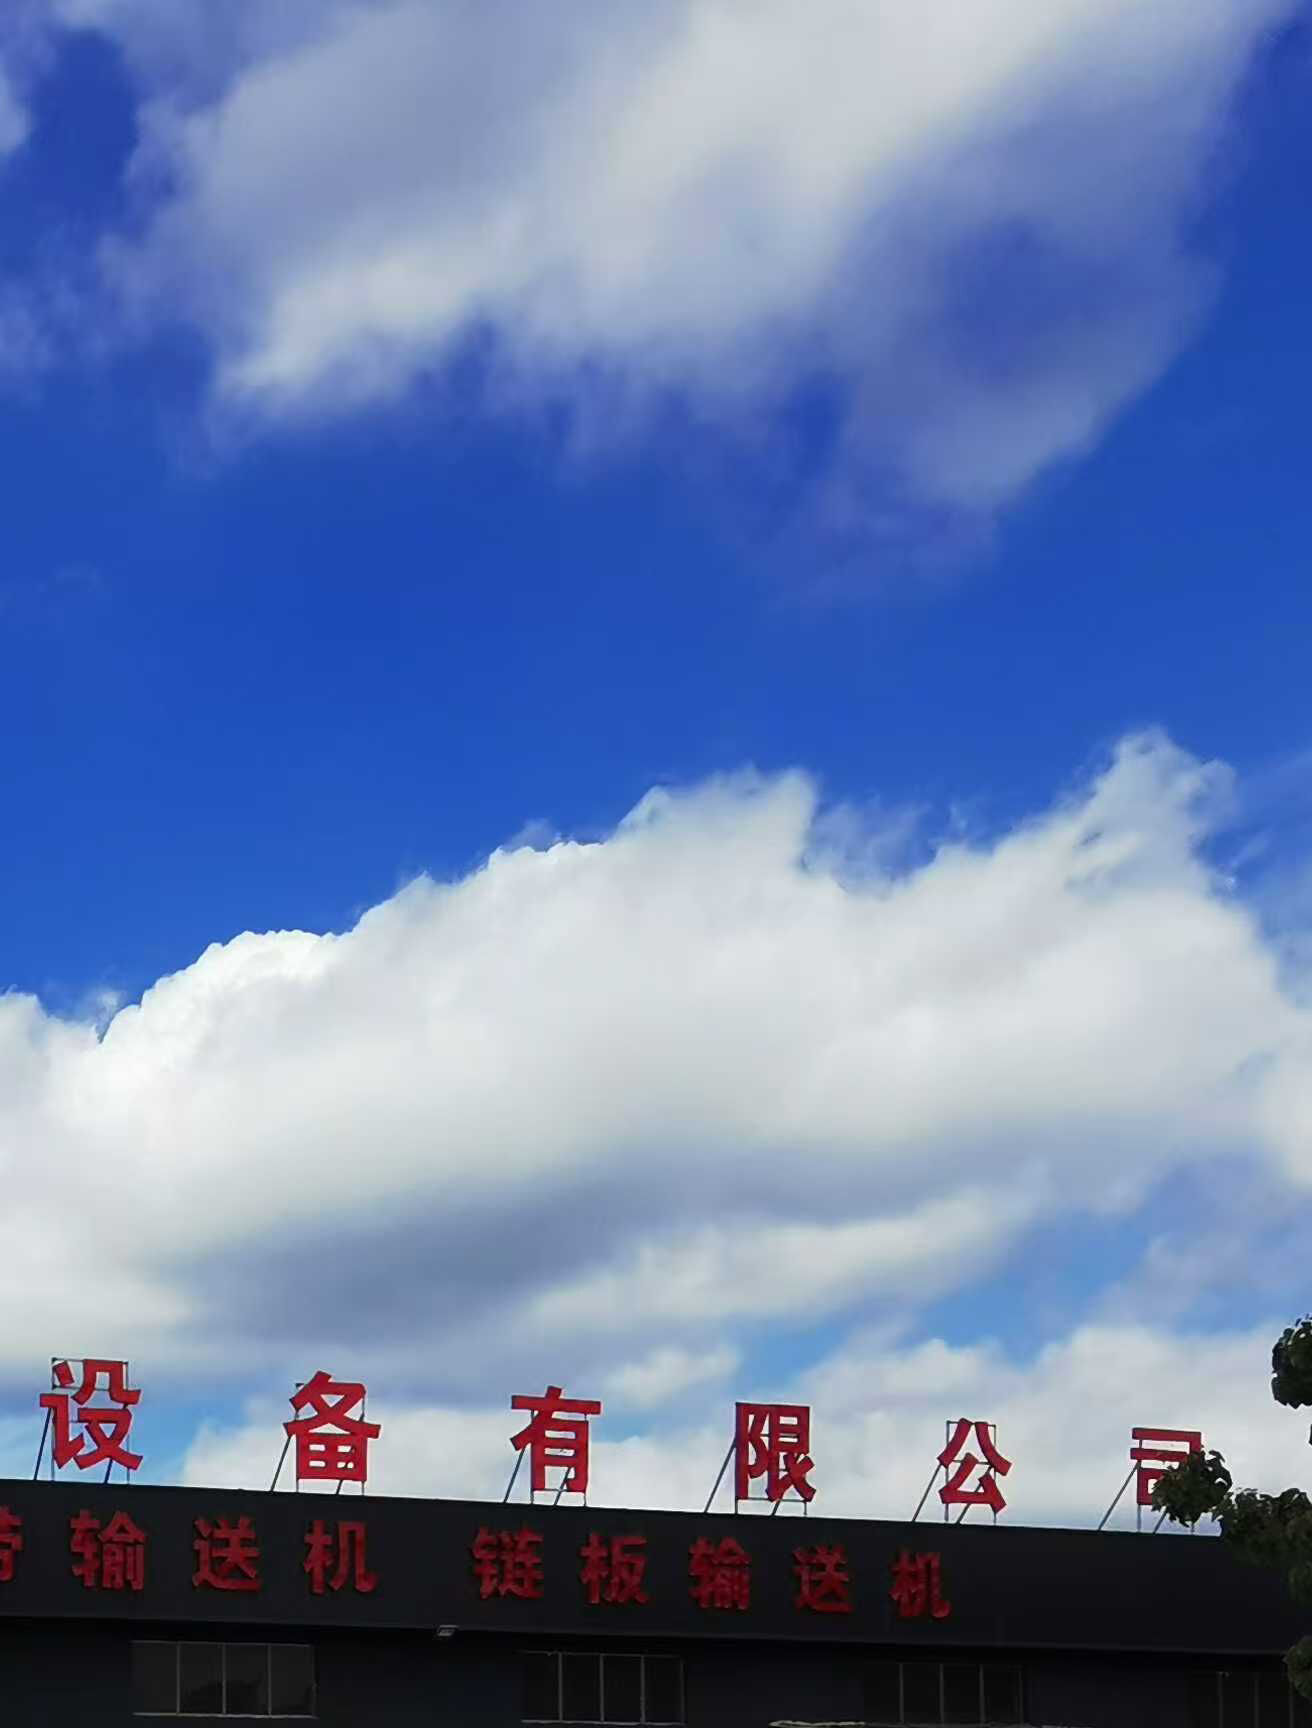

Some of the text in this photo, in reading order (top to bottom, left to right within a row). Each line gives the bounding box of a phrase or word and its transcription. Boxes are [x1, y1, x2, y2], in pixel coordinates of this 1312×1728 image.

[471, 1526, 951, 1618] 链板输送机
